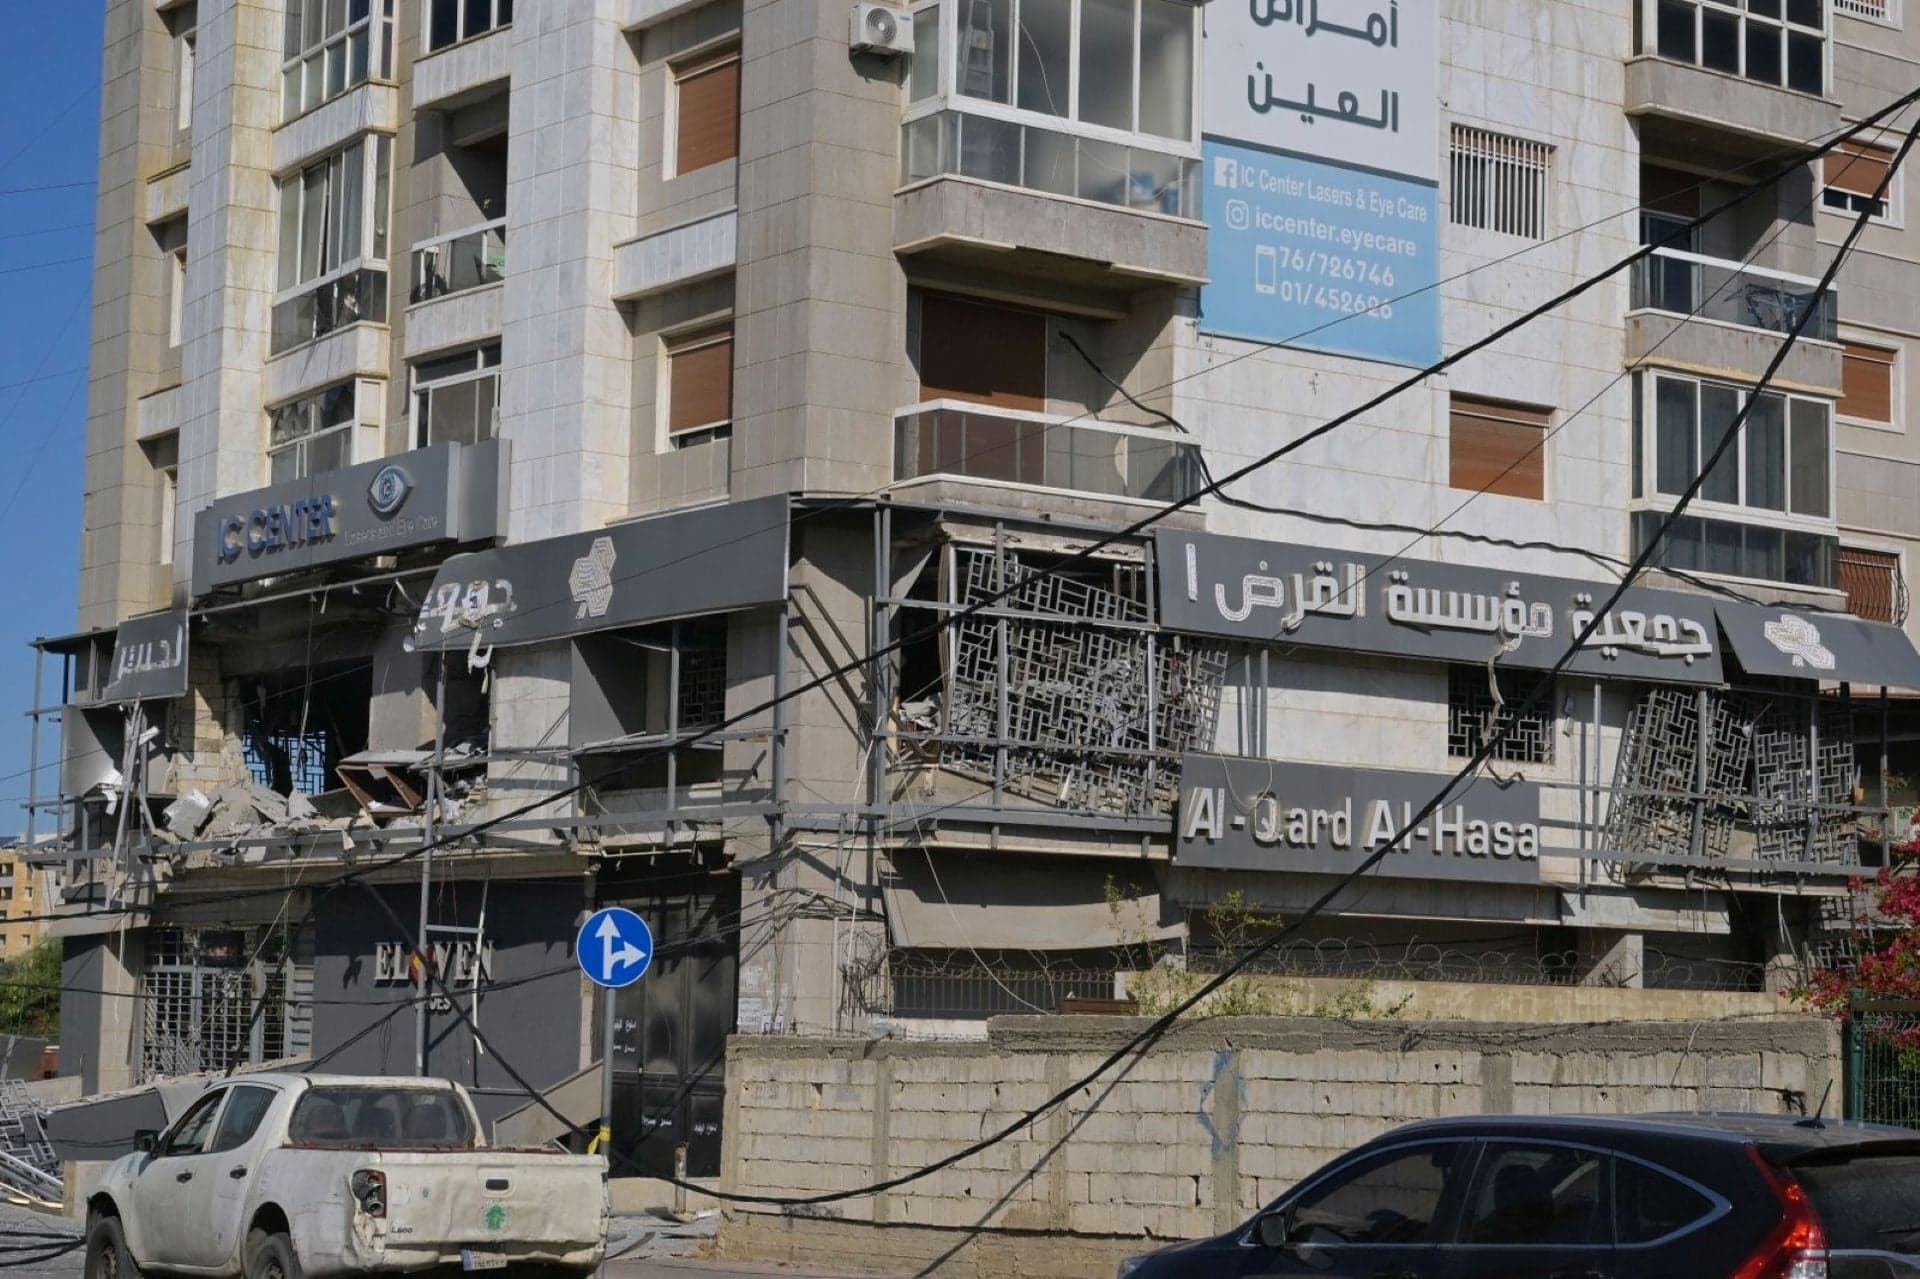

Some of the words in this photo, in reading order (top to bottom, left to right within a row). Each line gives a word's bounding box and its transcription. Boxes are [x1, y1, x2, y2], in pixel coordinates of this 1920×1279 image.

[1248, 61, 1399, 133] العين
[1241, 164, 1255, 187] IC
[1259, 169, 1304, 197] Center
[1307, 177, 1353, 208] Lasers
[1356, 187, 1366, 210] &
[1369, 191, 1395, 218] Eye
[1397, 197, 1428, 223] Care
[1256, 205, 1417, 257] iccenter.eyecare
[1279, 246, 1395, 287] 76/726746
[246, 496, 338, 553] CENTER
[1214, 560, 1366, 632] القرض
[1387, 570, 1553, 652] مؤسسة
[1570, 592, 1712, 664] جمعية
[1187, 787, 1352, 846] Al-Qard
